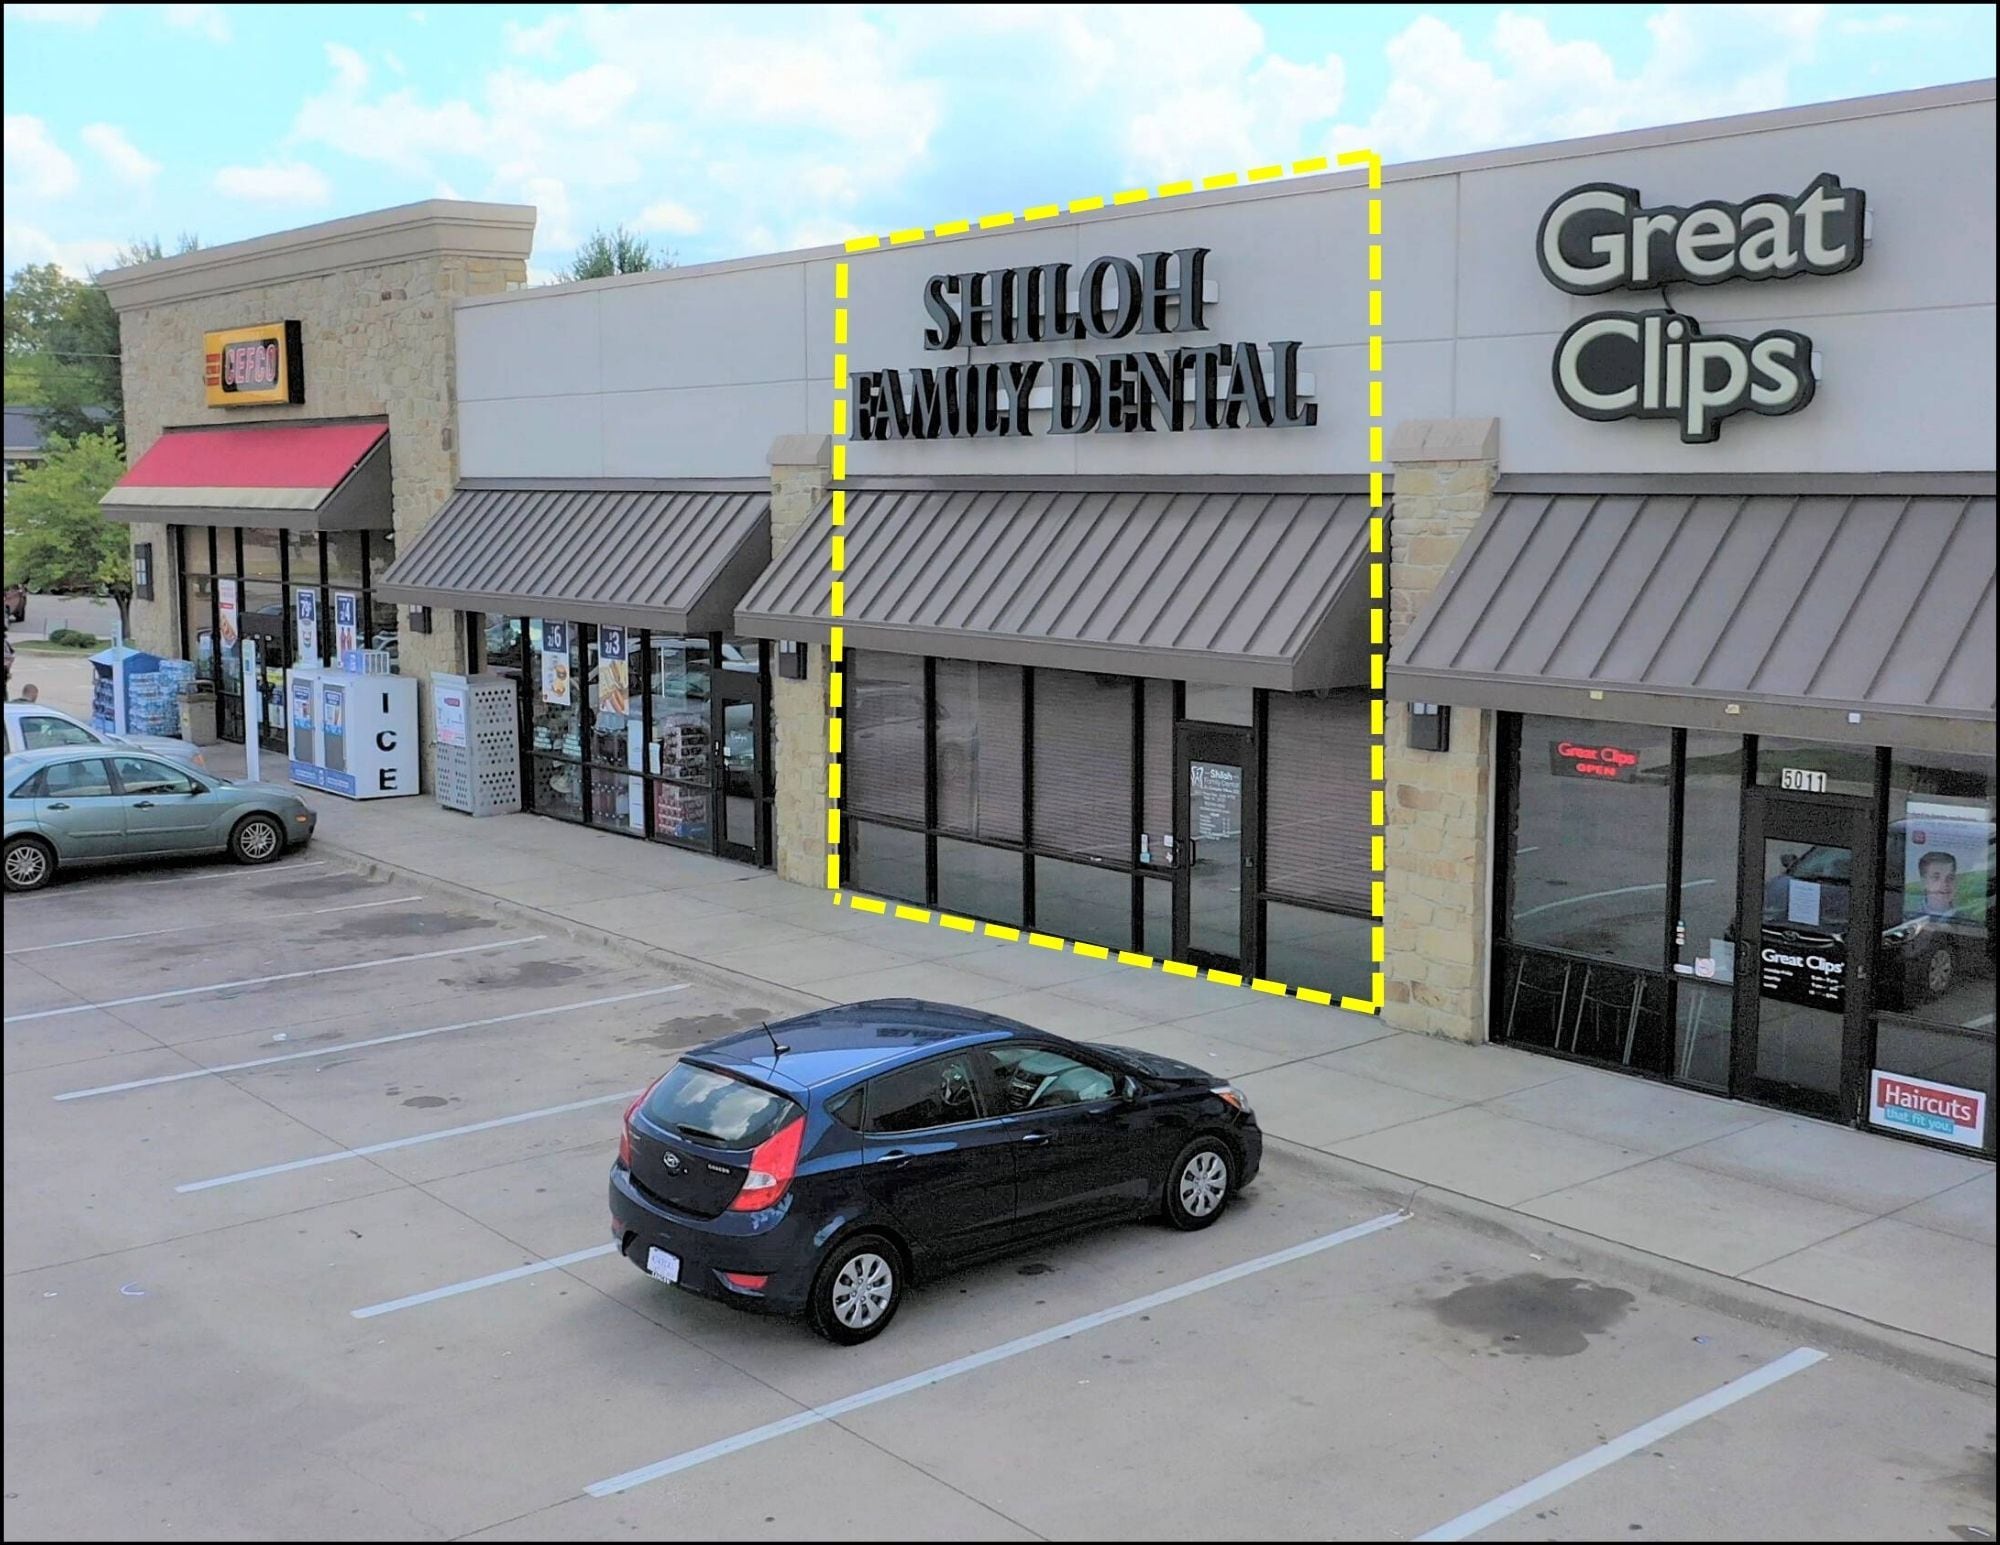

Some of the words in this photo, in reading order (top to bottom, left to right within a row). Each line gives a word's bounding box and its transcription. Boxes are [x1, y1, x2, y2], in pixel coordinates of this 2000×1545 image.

[1543, 186, 1847, 287] Great
[923, 248, 1211, 350] SHILOH
[224, 343, 278, 386] CEFCO
[1558, 316, 1799, 435] Clips
[849, 360, 1043, 441] FAMILY
[1047, 341, 1318, 435] DENTAL
[1557, 742, 1599, 760] Great
[1600, 748, 1638, 767] Clips
[1575, 762, 1617, 777] OPEN
[1783, 770, 1824, 791] 5011
[1761, 948, 1805, 968] Great
[1805, 955, 1845, 976] Clips
[1884, 1083, 1972, 1121] Haircuts
[1886, 1107, 1909, 1120] that
[1911, 1111, 1928, 1128] fit
